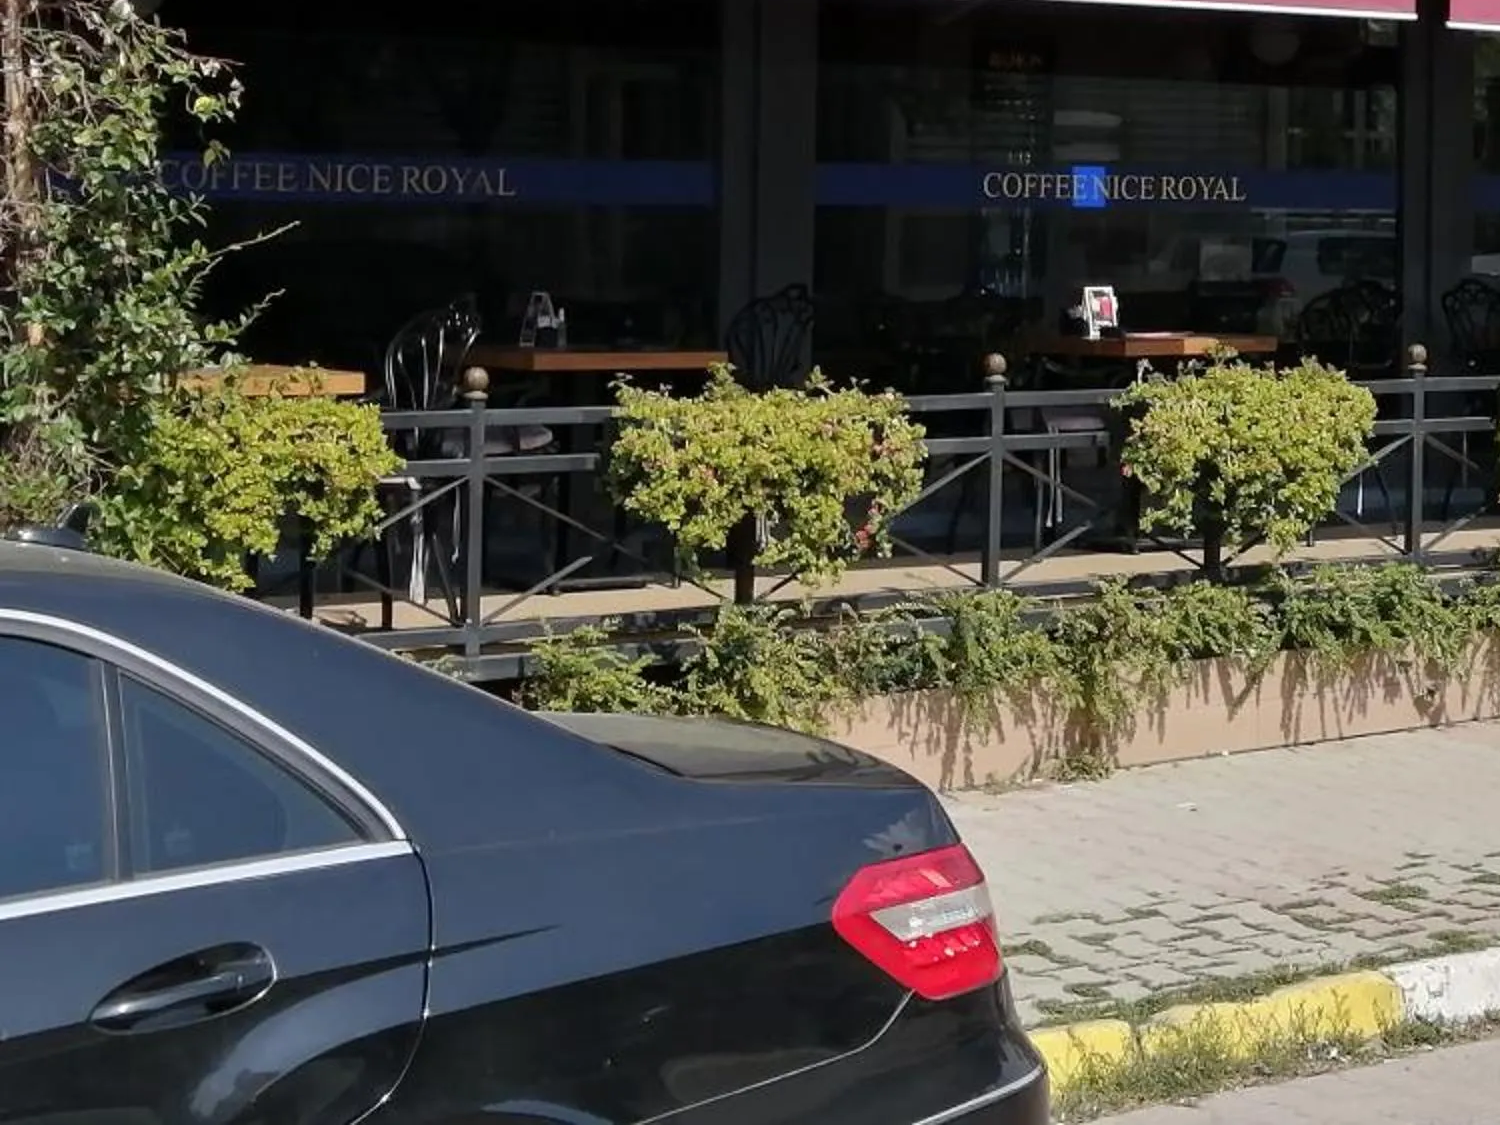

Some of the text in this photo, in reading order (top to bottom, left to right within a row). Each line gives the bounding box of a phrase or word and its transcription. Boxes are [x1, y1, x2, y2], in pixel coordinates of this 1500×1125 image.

[156, 159, 518, 198] COFFEE NICE ROYAL
[983, 171, 1247, 202] COFFEE NICE ROYAL
